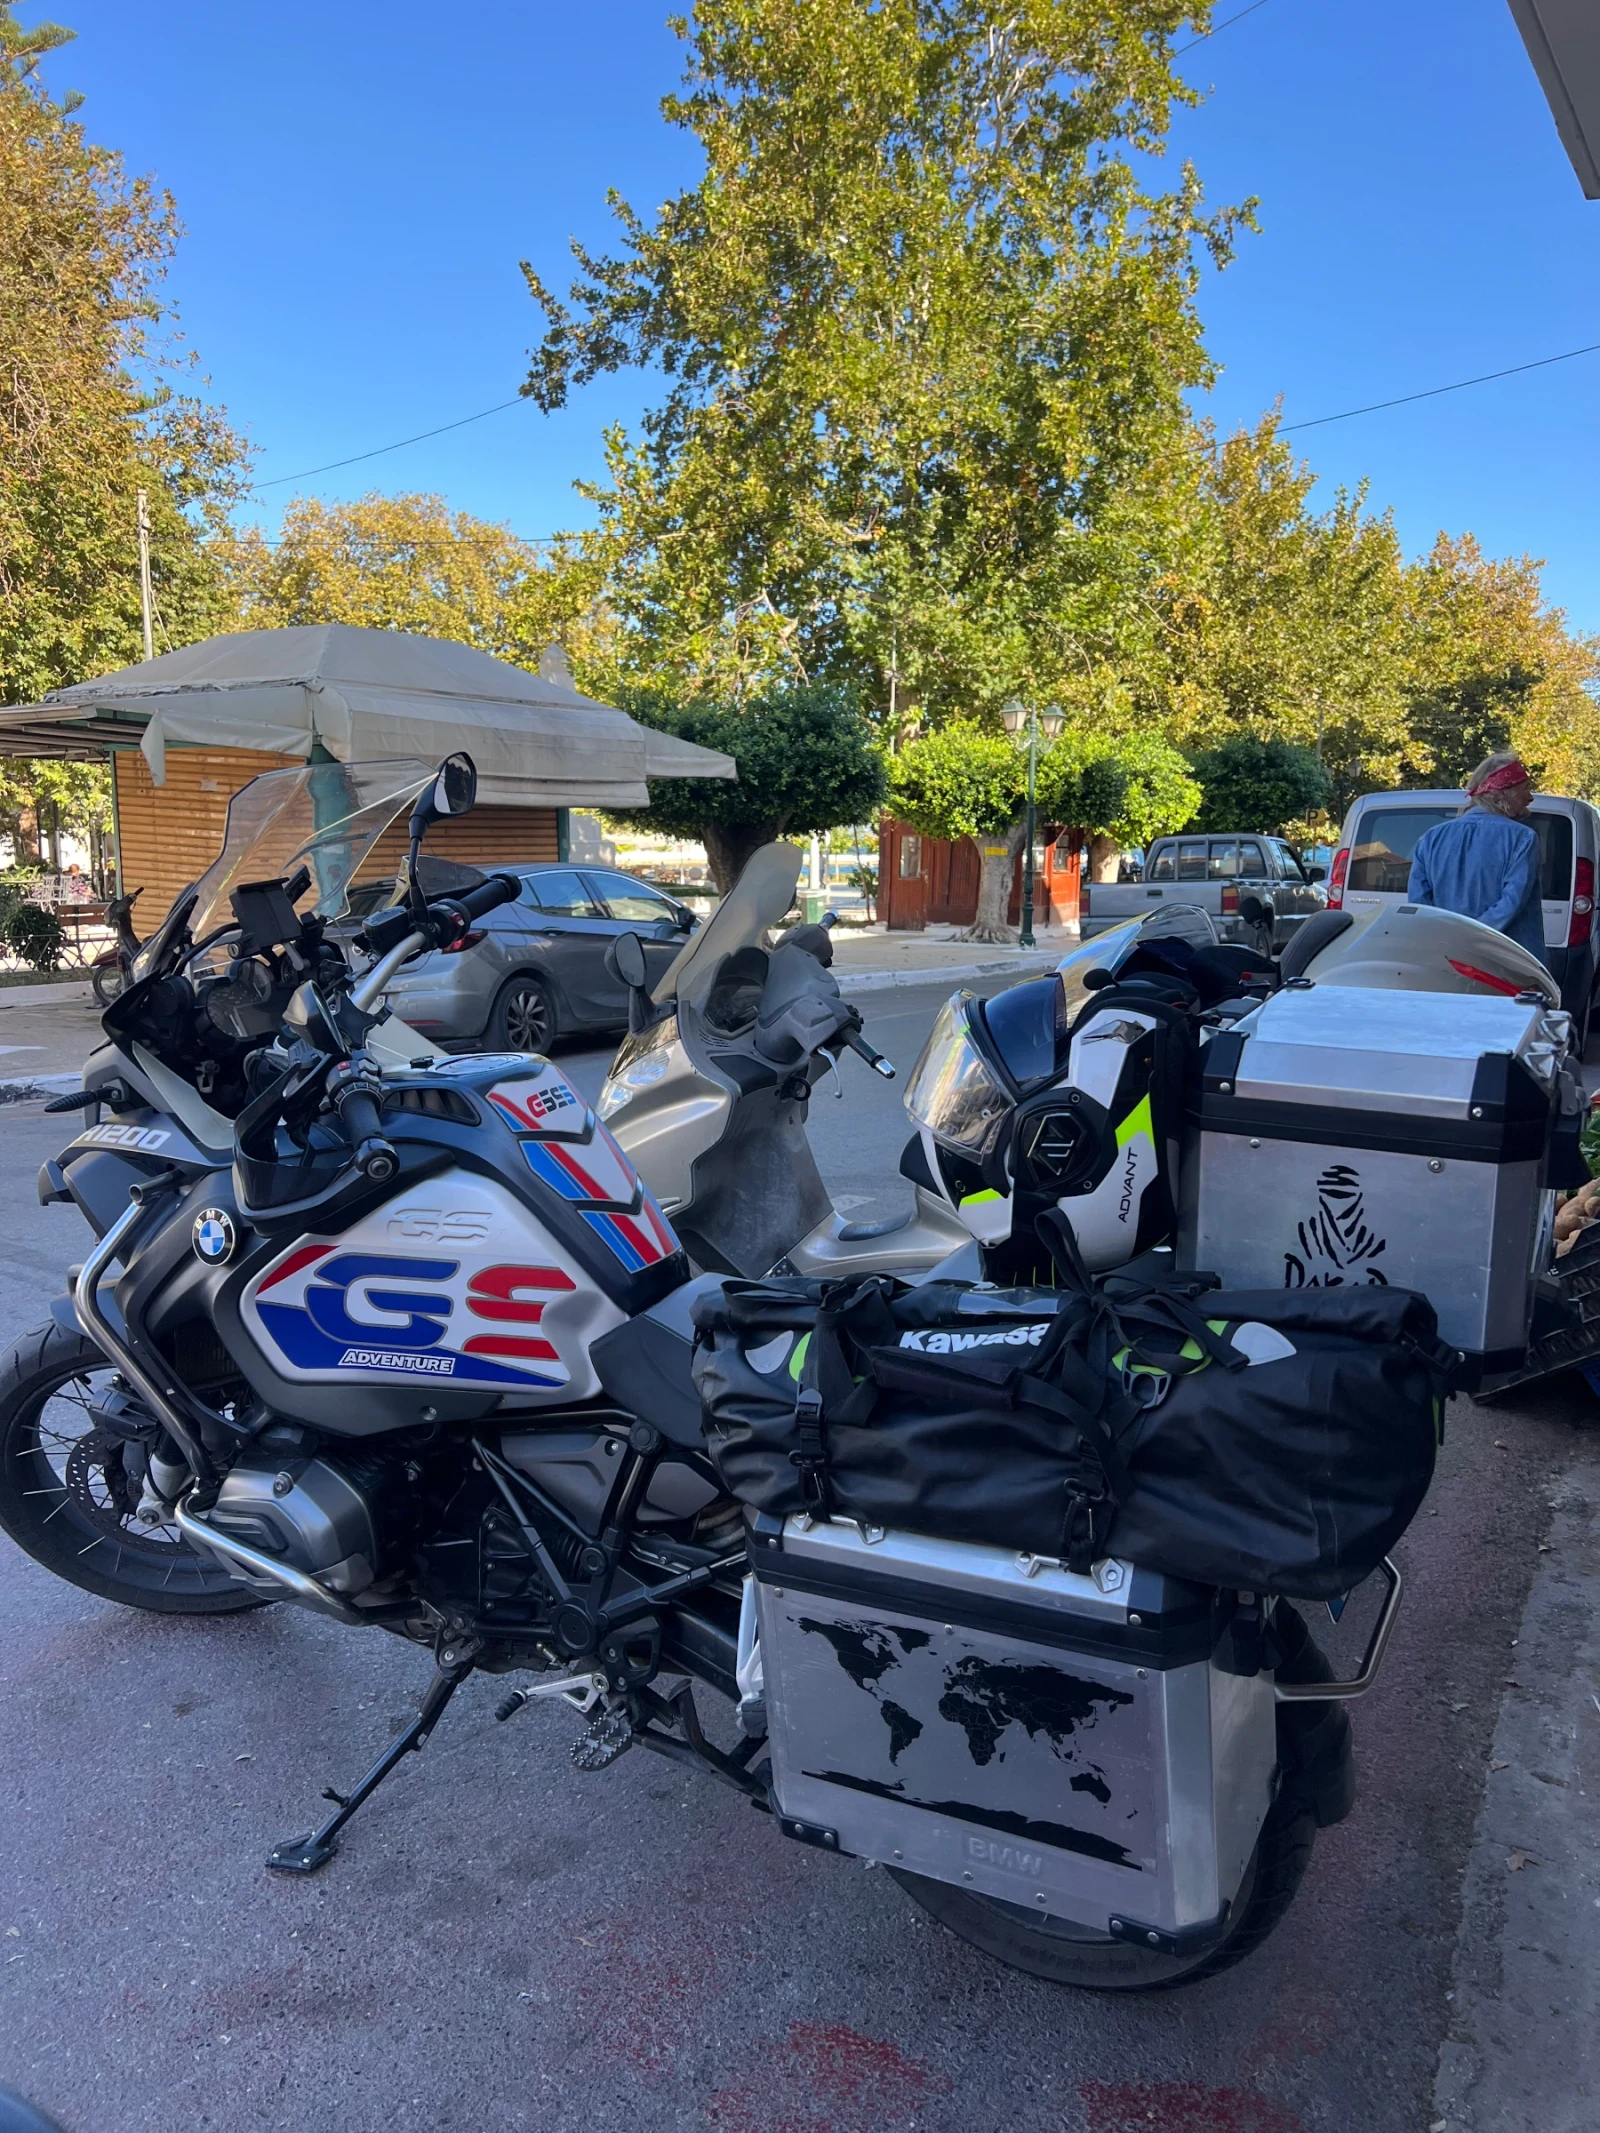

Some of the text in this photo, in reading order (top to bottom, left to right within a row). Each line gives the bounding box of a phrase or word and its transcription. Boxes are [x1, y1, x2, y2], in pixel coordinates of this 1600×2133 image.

[1307, 810, 1318, 826] P
[1118, 1146, 1138, 1223] ADVANT
[194, 1210, 230, 1230] BMW
[387, 1208, 493, 1247] GS
[304, 1252, 576, 1361] GS
[343, 1350, 453, 1372] ADVENTURE
[969, 1837, 1043, 1876] BMW
